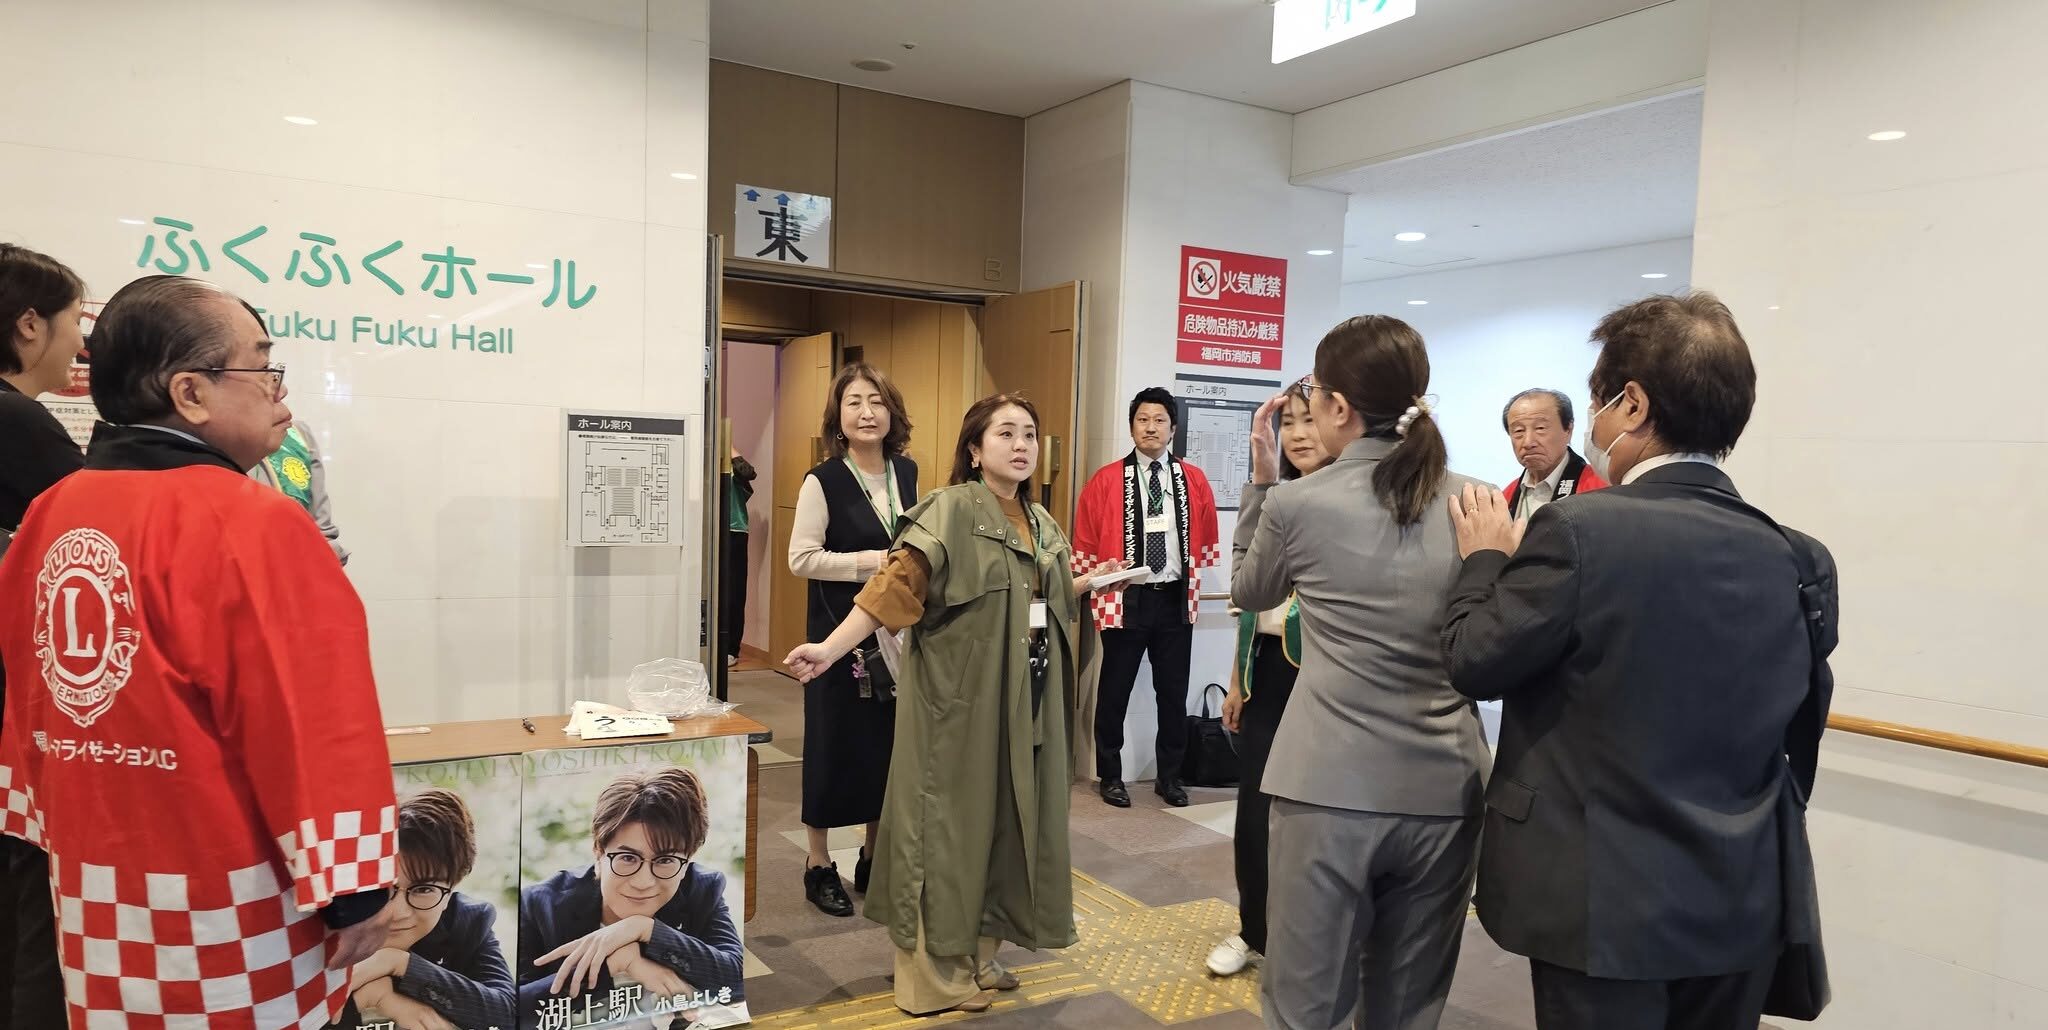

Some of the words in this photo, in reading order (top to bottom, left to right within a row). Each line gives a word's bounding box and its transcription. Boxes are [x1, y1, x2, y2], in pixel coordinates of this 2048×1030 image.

[755, 206, 809, 263] 東
[137, 216, 597, 309] ふくふくホール
[1221, 269, 1281, 299] 火気厳禁
[352, 316, 437, 348] Fuku
[452, 324, 513, 354] Hall
[1183, 314, 1279, 342] 危険物品持込み厳禁
[1201, 346, 1261, 365] 福岡市消防局
[1185, 384, 1227, 397] ホール案内
[578, 418, 632, 431] ホール案内
[50, 537, 111, 577] LIONS
[62, 588, 97, 657] L
[523, 748, 640, 776] YOSHIKI
[535, 983, 643, 1030] 湖上駅
[655, 985, 732, 1013] 小島よしき
